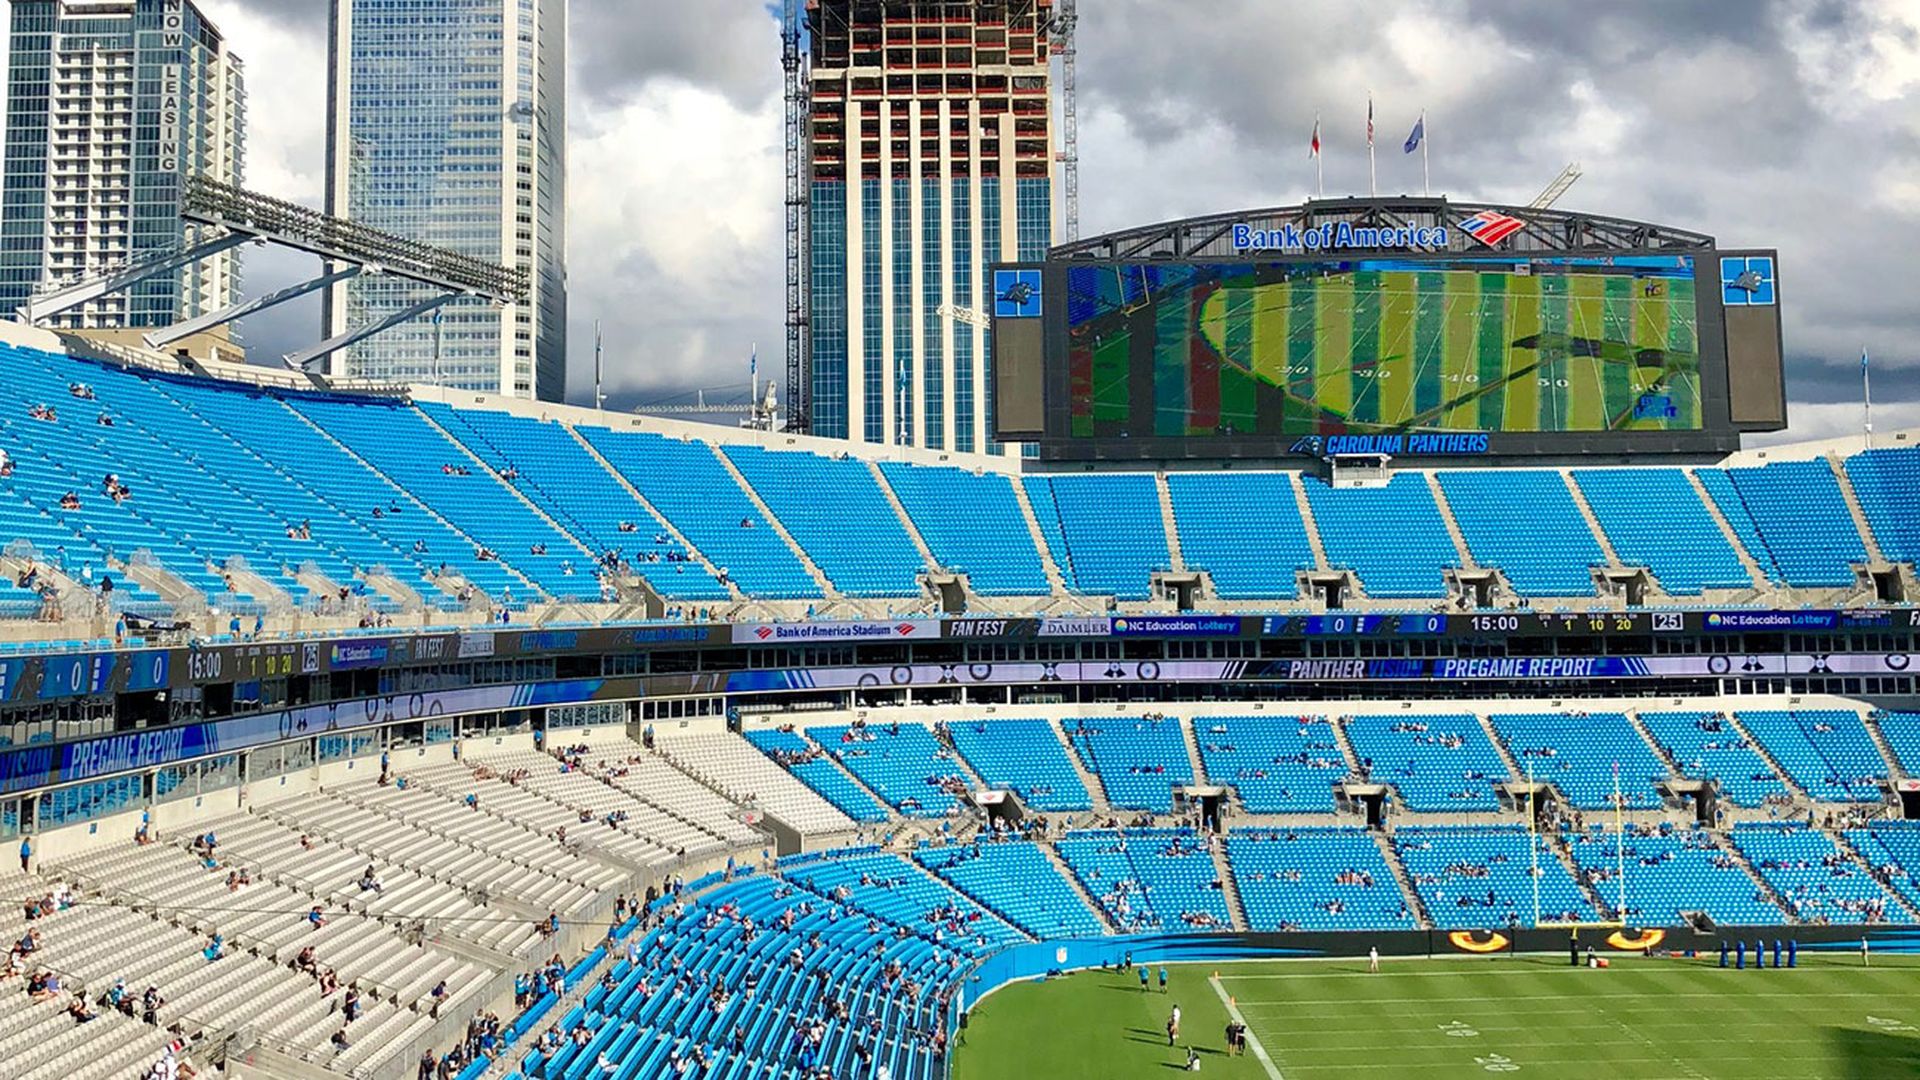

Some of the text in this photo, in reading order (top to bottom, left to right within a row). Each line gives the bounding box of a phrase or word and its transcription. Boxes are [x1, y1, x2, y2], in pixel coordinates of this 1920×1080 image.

[162, 0, 181, 170] NOW LEASING
[1232, 221, 1447, 249] Bank of America
[1326, 433, 1488, 453] CAROLINA PANTHERS
[1128, 620, 1236, 632] NC Education Lottery
[1334, 618, 1345, 632] 0
[1427, 617, 1438, 632] 0
[1471, 616, 1518, 630] 15:00
[1564, 620, 1571, 631] 1
[1589, 620, 1604, 631] 10
[1616, 620, 1632, 631] 20
[1659, 616, 1677, 629] 25
[1722, 615, 1738, 625] NC
[1739, 614, 1791, 625] Education
[1792, 614, 1832, 626] Lottery
[776, 623, 891, 638] Bank of America Stadium
[950, 620, 1008, 636] FAN FEST
[1047, 624, 1109, 634] DAIMLER
[153, 657, 162, 684] 0
[187, 652, 221, 679] 15:00
[1289, 660, 1365, 678] PANTHER
[1444, 657, 1596, 678] PREGAME REPORT
[71, 661, 82, 691] 0
[69, 727, 186, 779] PREGAME REPORT
